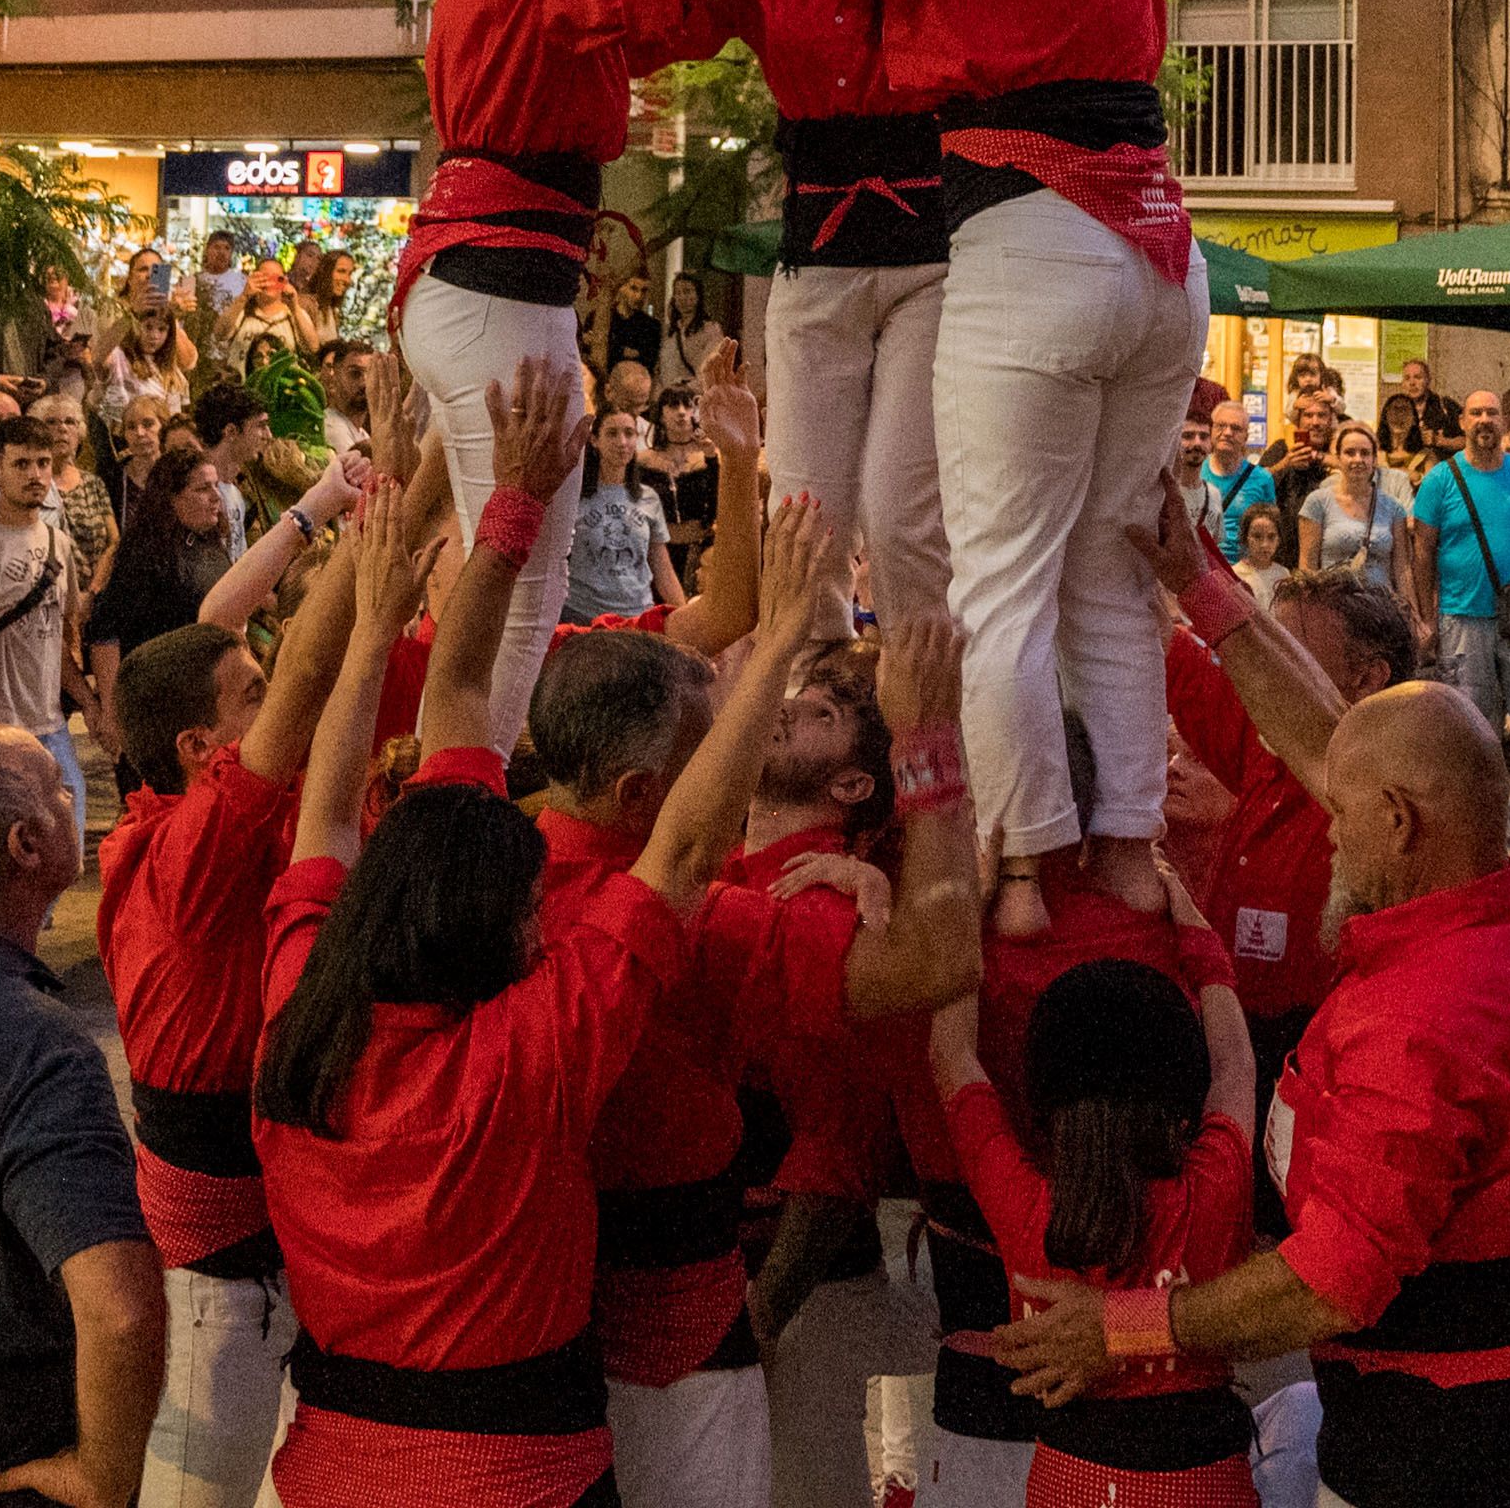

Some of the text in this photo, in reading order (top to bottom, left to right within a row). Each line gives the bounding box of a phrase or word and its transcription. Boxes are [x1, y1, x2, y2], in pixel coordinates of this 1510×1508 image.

[227, 152, 299, 185] edos
[1446, 286, 1505, 295] DOBLE MALTA
